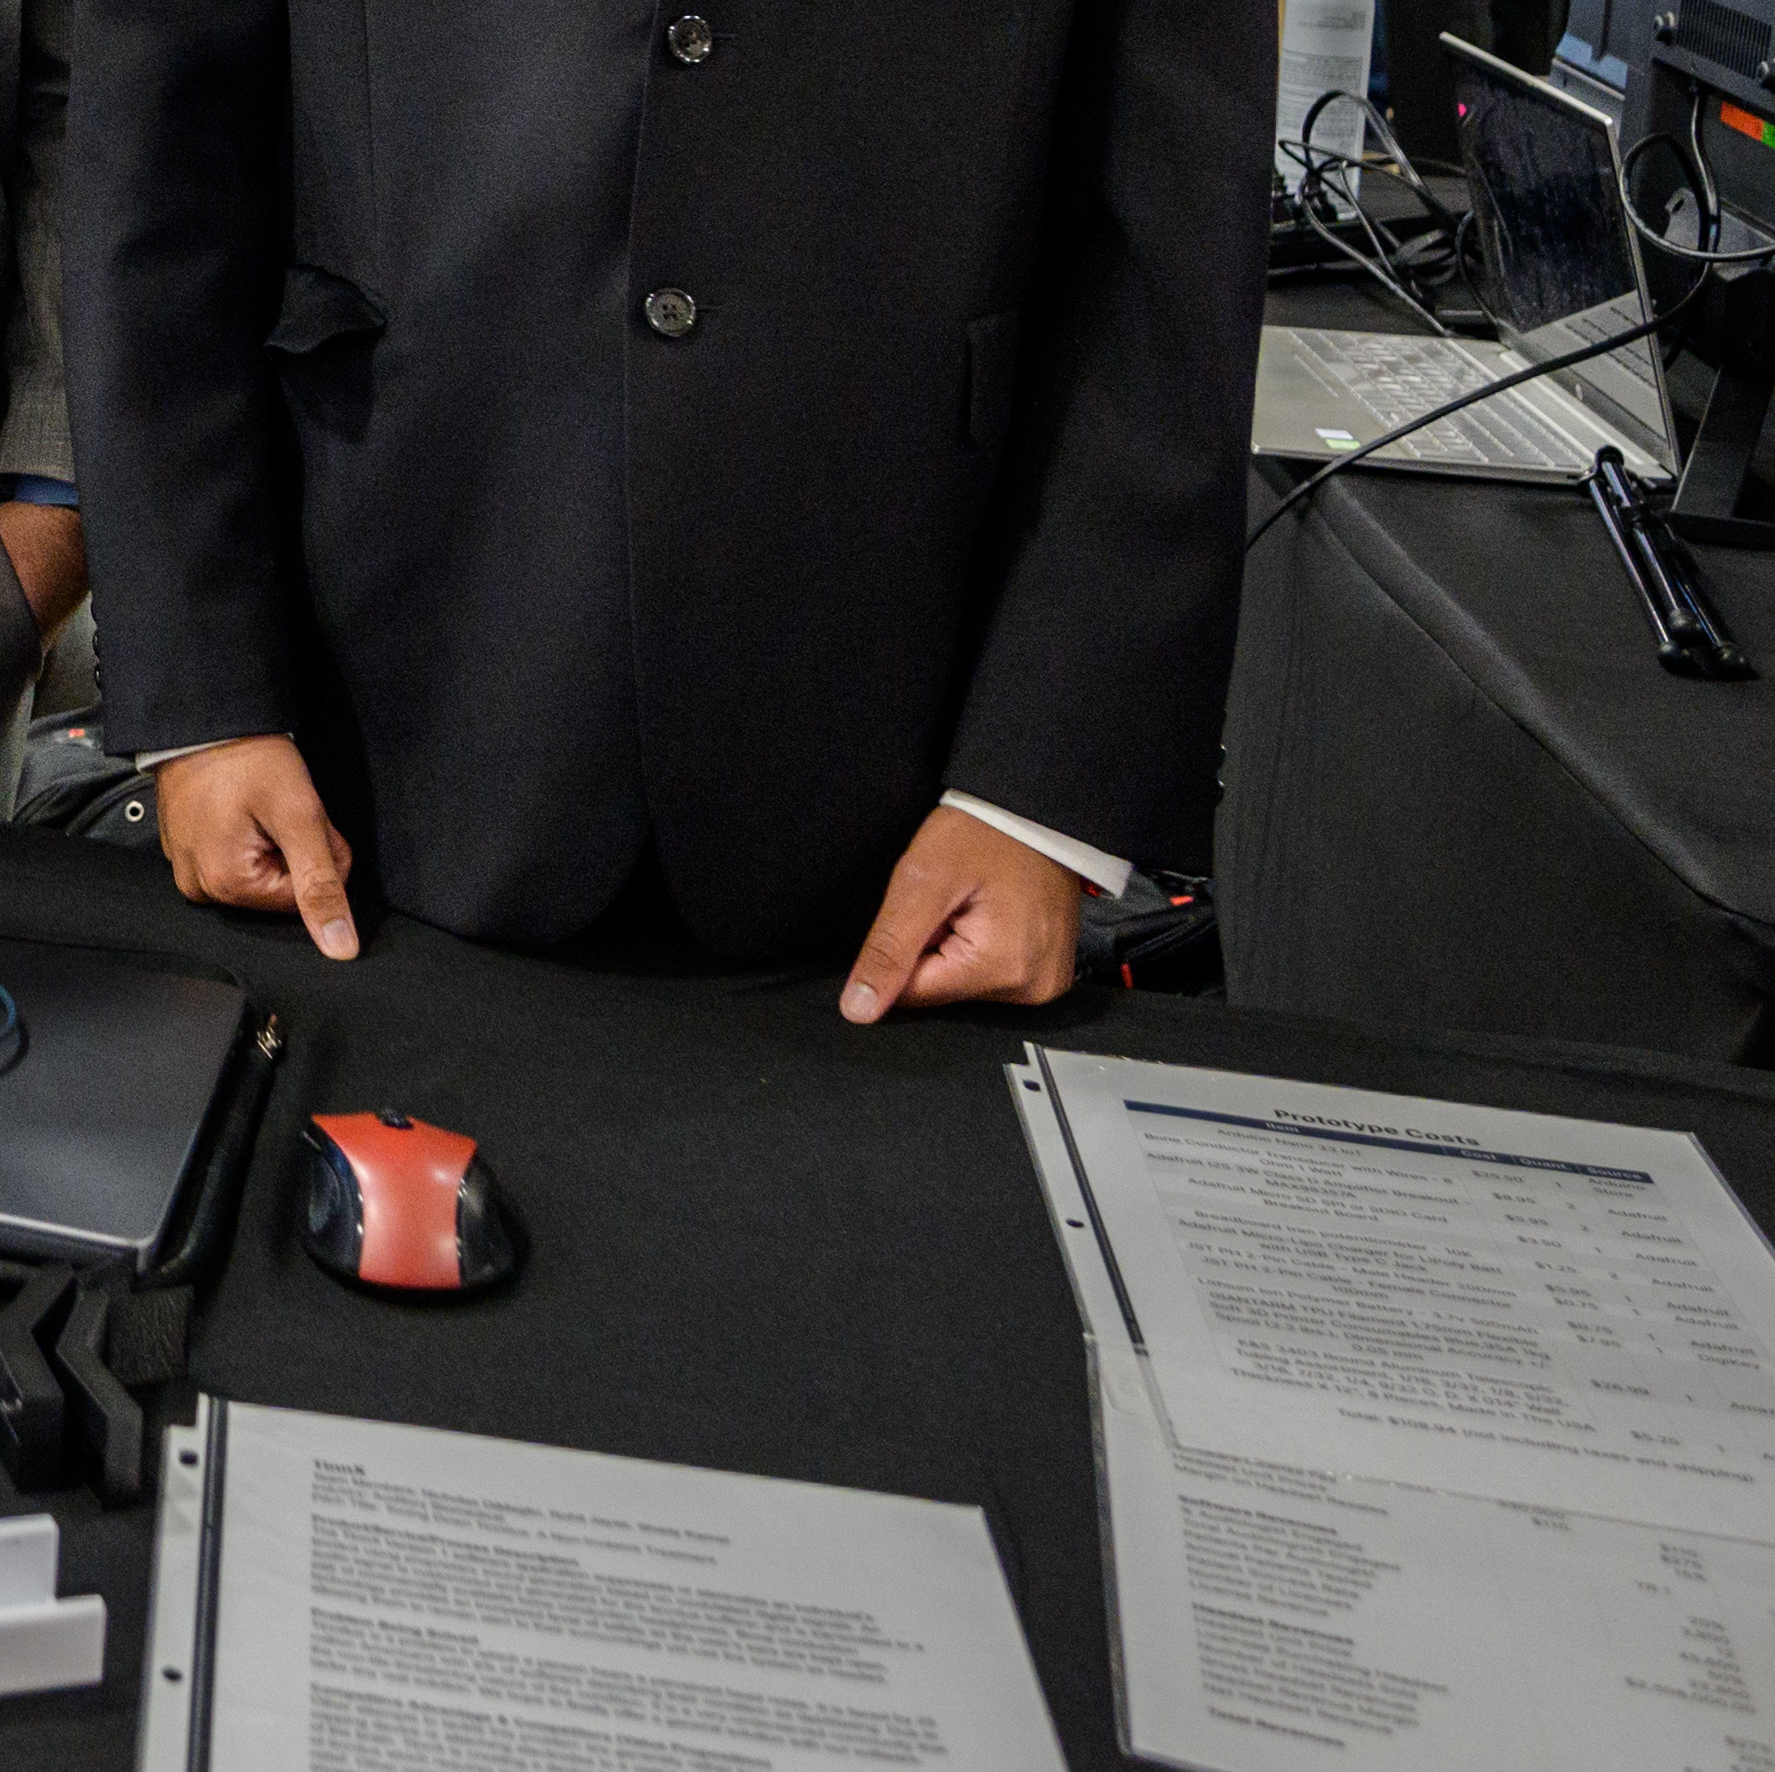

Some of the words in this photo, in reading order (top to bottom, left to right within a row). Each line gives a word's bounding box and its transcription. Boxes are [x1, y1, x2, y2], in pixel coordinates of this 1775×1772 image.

[1272, 1108, 1399, 1139] Prototype
[1403, 1123, 1481, 1148] Costs
[1459, 1148, 1498, 1162] Cost
[1584, 1164, 1646, 1182] Source
